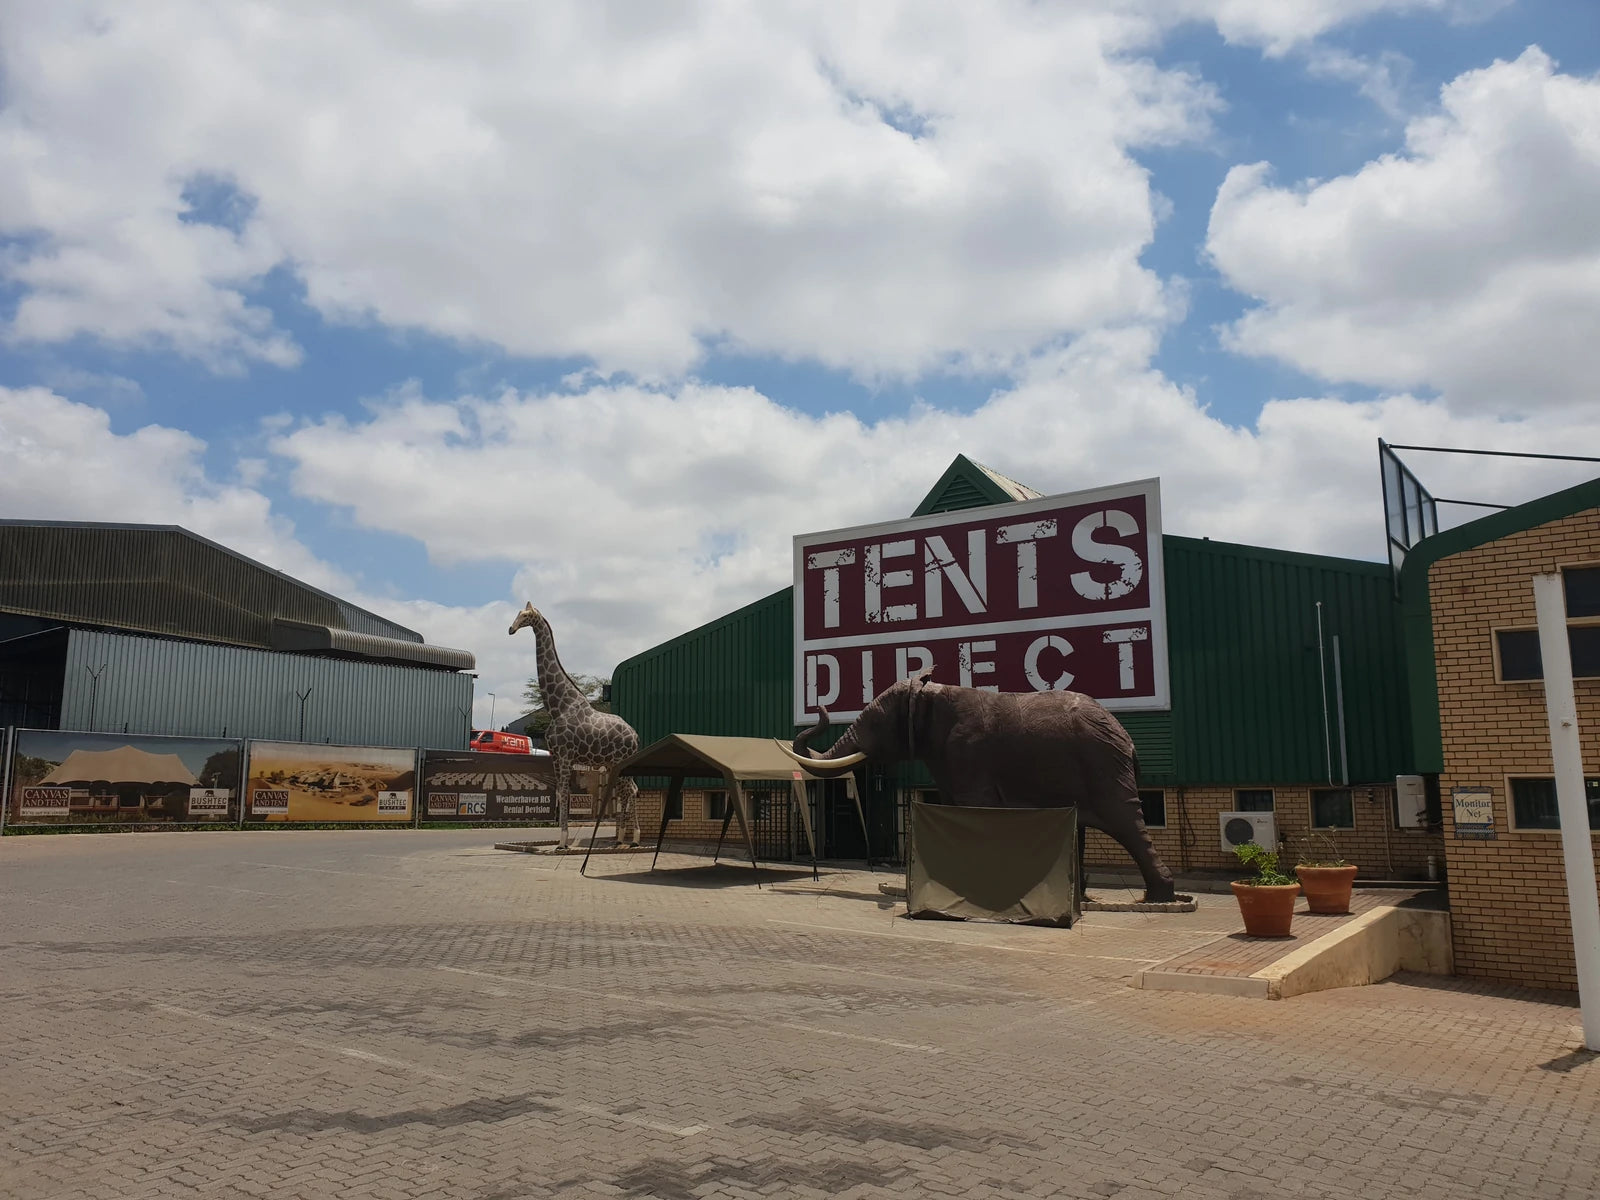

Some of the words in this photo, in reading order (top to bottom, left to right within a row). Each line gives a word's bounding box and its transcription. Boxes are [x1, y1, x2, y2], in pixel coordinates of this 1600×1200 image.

[808, 509, 1143, 628] TENTS
[505, 737, 525, 748] ram
[24, 789, 69, 799] CANVAS
[255, 791, 288, 800] CANVAS
[495, 795, 539, 803] Weatherhaven
[540, 795, 551, 803] RCS
[24, 799, 44, 807] AND
[45, 799, 68, 807] TENT
[191, 797, 227, 805] BUSHTEC
[1455, 798, 1491, 808] Monitor
[467, 803, 486, 814] RCS
[503, 806, 524, 814] Rental
[1466, 808, 1482, 818] Net
